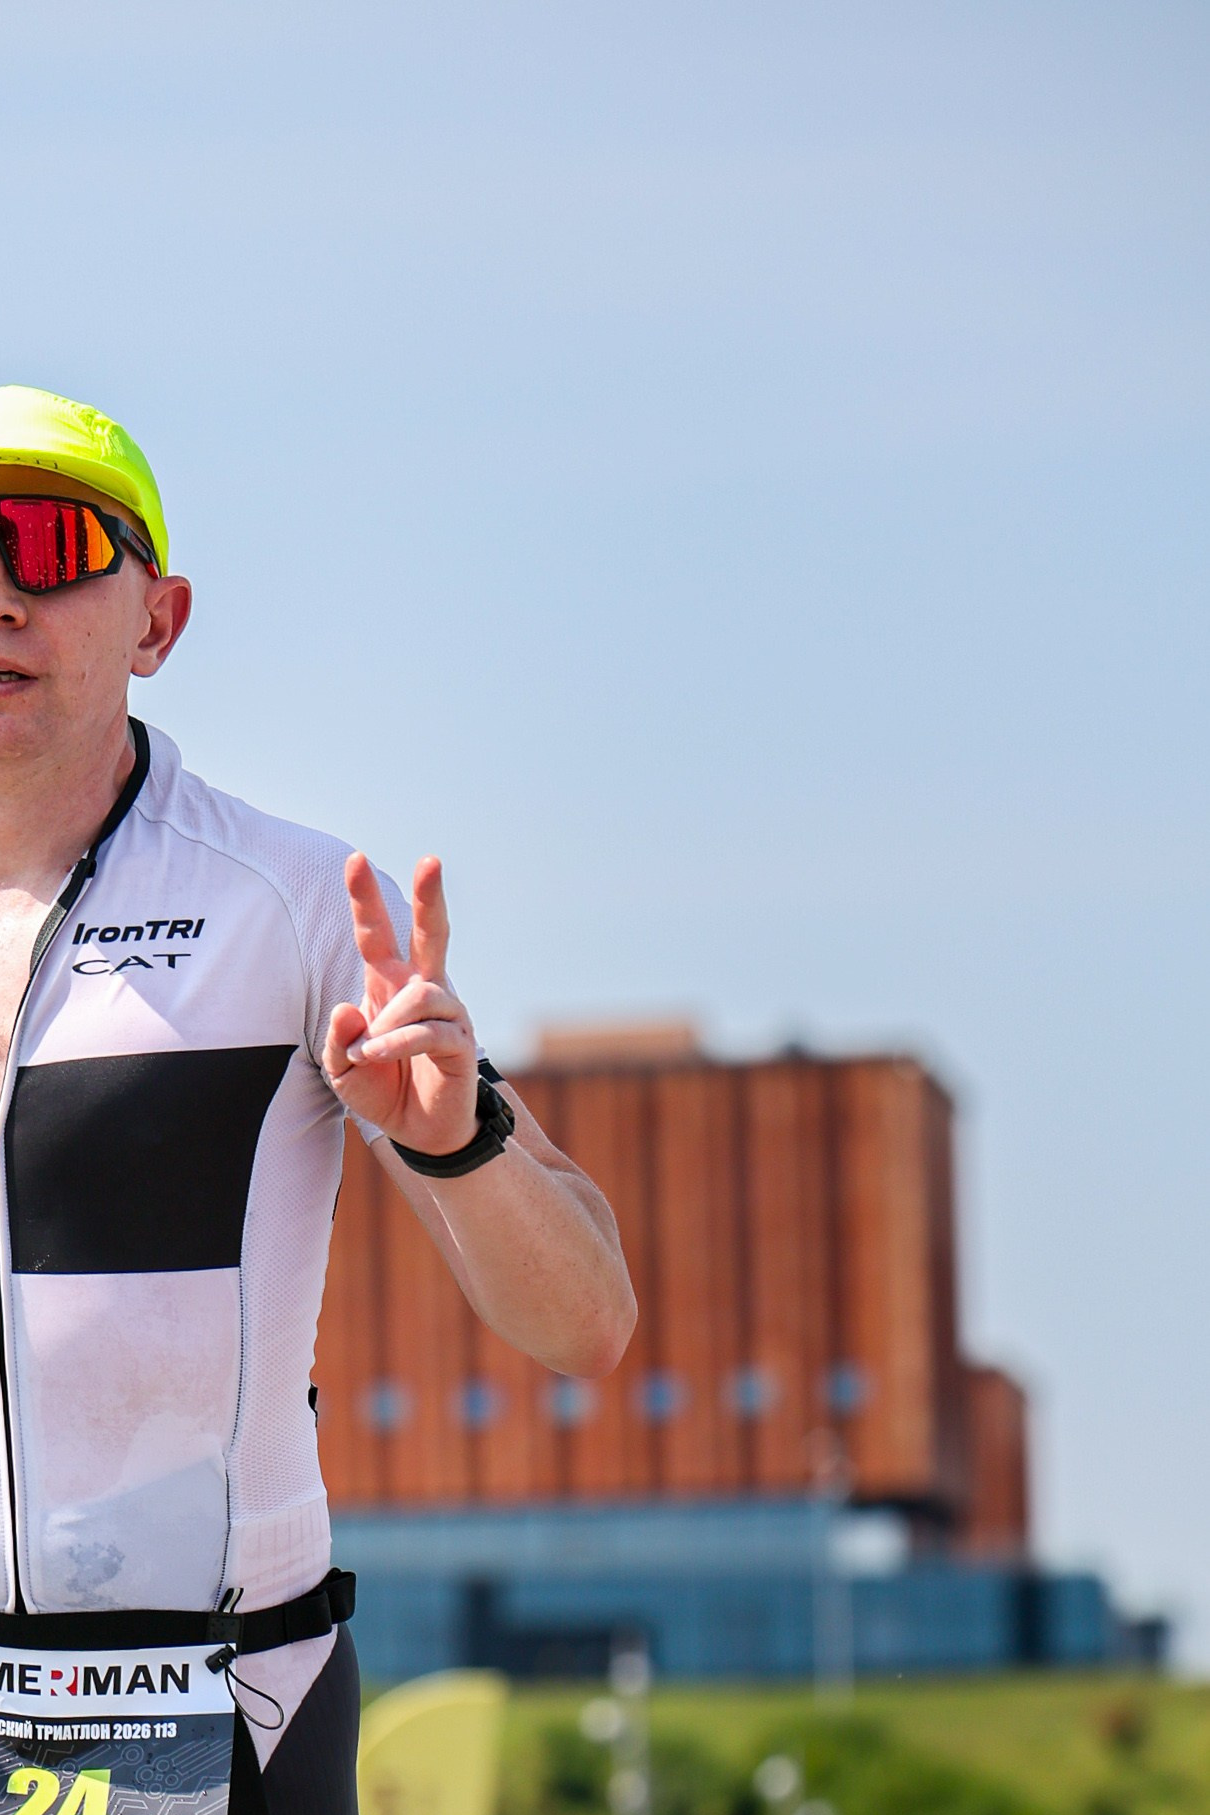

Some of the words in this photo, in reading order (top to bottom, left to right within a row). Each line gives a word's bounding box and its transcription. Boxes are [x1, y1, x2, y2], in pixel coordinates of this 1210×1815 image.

[71, 917, 206, 945] IronTRI
[71, 952, 192, 976] CAT
[36, 1722, 110, 1741] ТРИАТЛОН
[112, 1722, 151, 1740] 2026
[153, 1721, 177, 1739] 113
